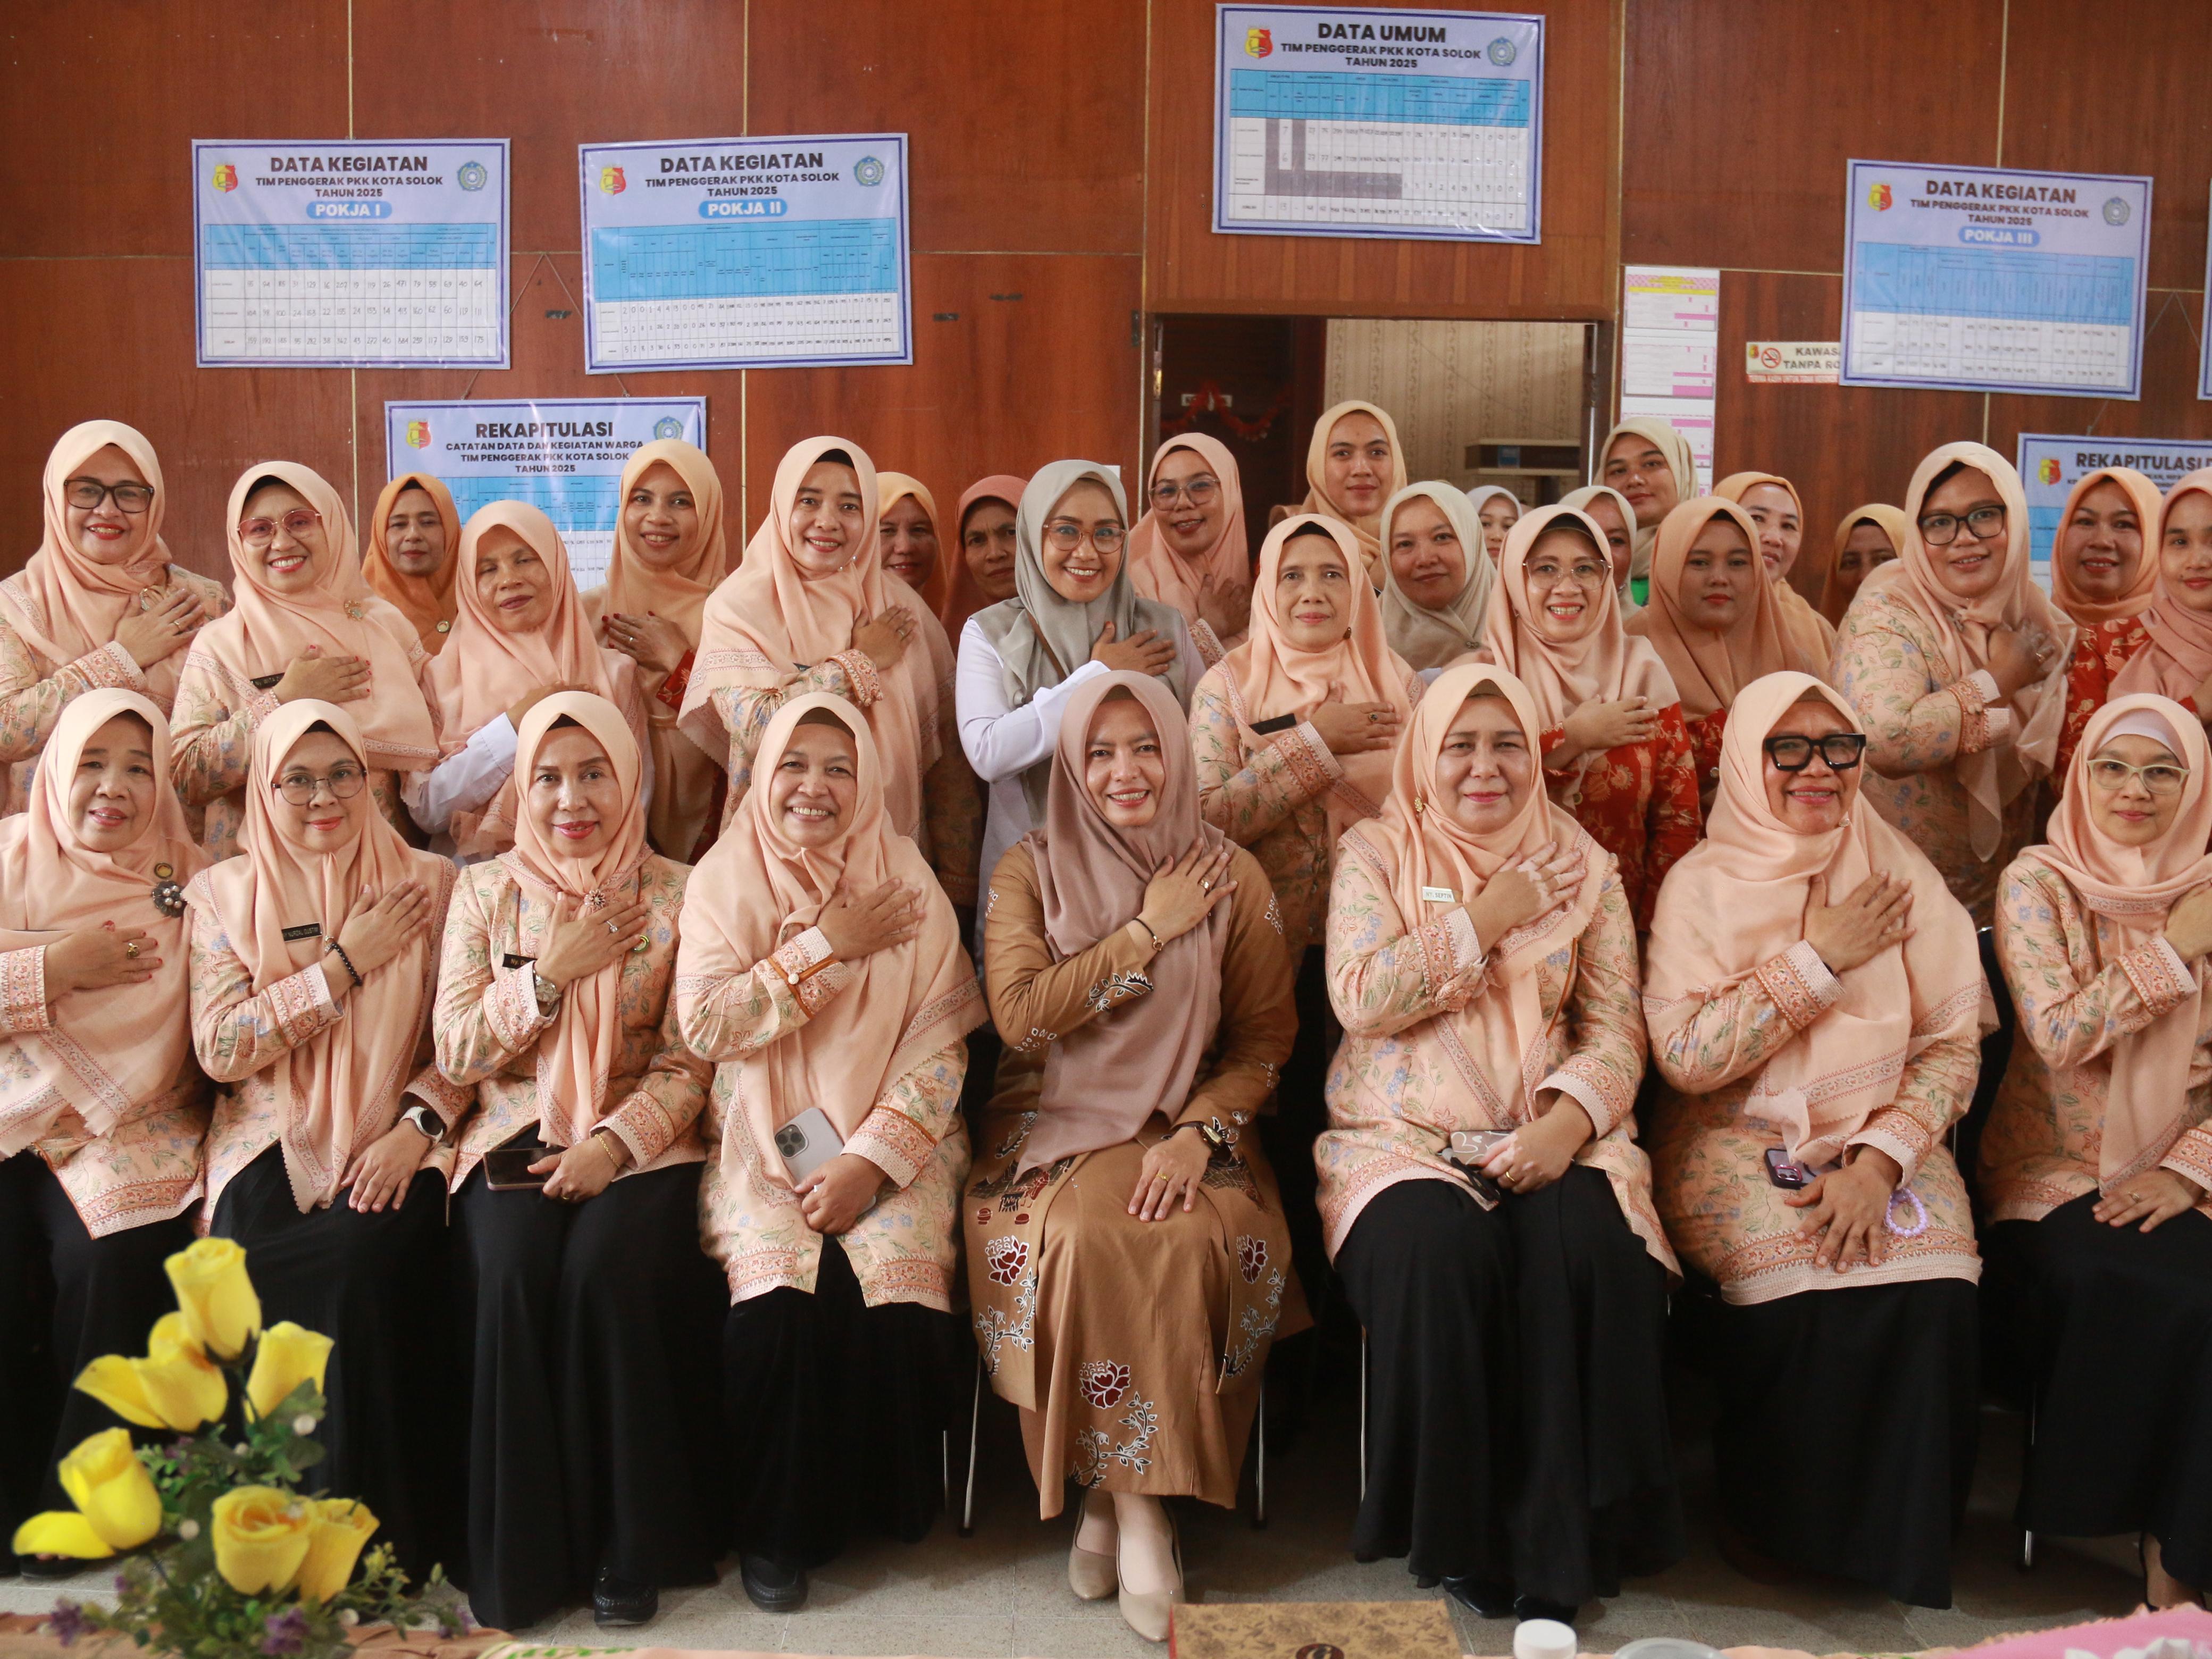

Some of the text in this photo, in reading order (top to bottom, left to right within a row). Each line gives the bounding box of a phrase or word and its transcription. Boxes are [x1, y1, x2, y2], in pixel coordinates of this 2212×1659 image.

[1318, 23, 1446, 43] DATA UMUM
[1281, 43, 1481, 59] TIM PENGGERAK PKK KOTA SOLOK
[1345, 57, 1417, 68] TAHUN 2025
[271, 156, 428, 172] DATA KEGIATAN
[660, 153, 823, 173] DATA KEGIATAN
[255, 178, 275, 186] TIM
[278, 177, 344, 186] PENGGERAK
[372, 177, 404, 185] KOTA
[406, 177, 442, 185] SOLOK
[645, 173, 839, 187] TIM PENGGERAK PKK KOTA SOLOK
[315, 188, 382, 197] TAHUN 2025
[707, 186, 777, 197] TAHUN 2025
[1926, 180, 2075, 204] DATA KEGIATAN
[315, 204, 380, 216] POKJA I
[708, 201, 781, 216] POKJA II
[1911, 199, 2089, 218] TIM PENGGERAK PKK KOTA SOLOK
[1968, 214, 2032, 226] TAHUN 2025
[1965, 229, 2033, 244] POKJA III
[1783, 361, 1821, 369] TANPA
[476, 422, 613, 438] REKAPITULASI
[2076, 453, 2202, 471] REKAPITULASI
